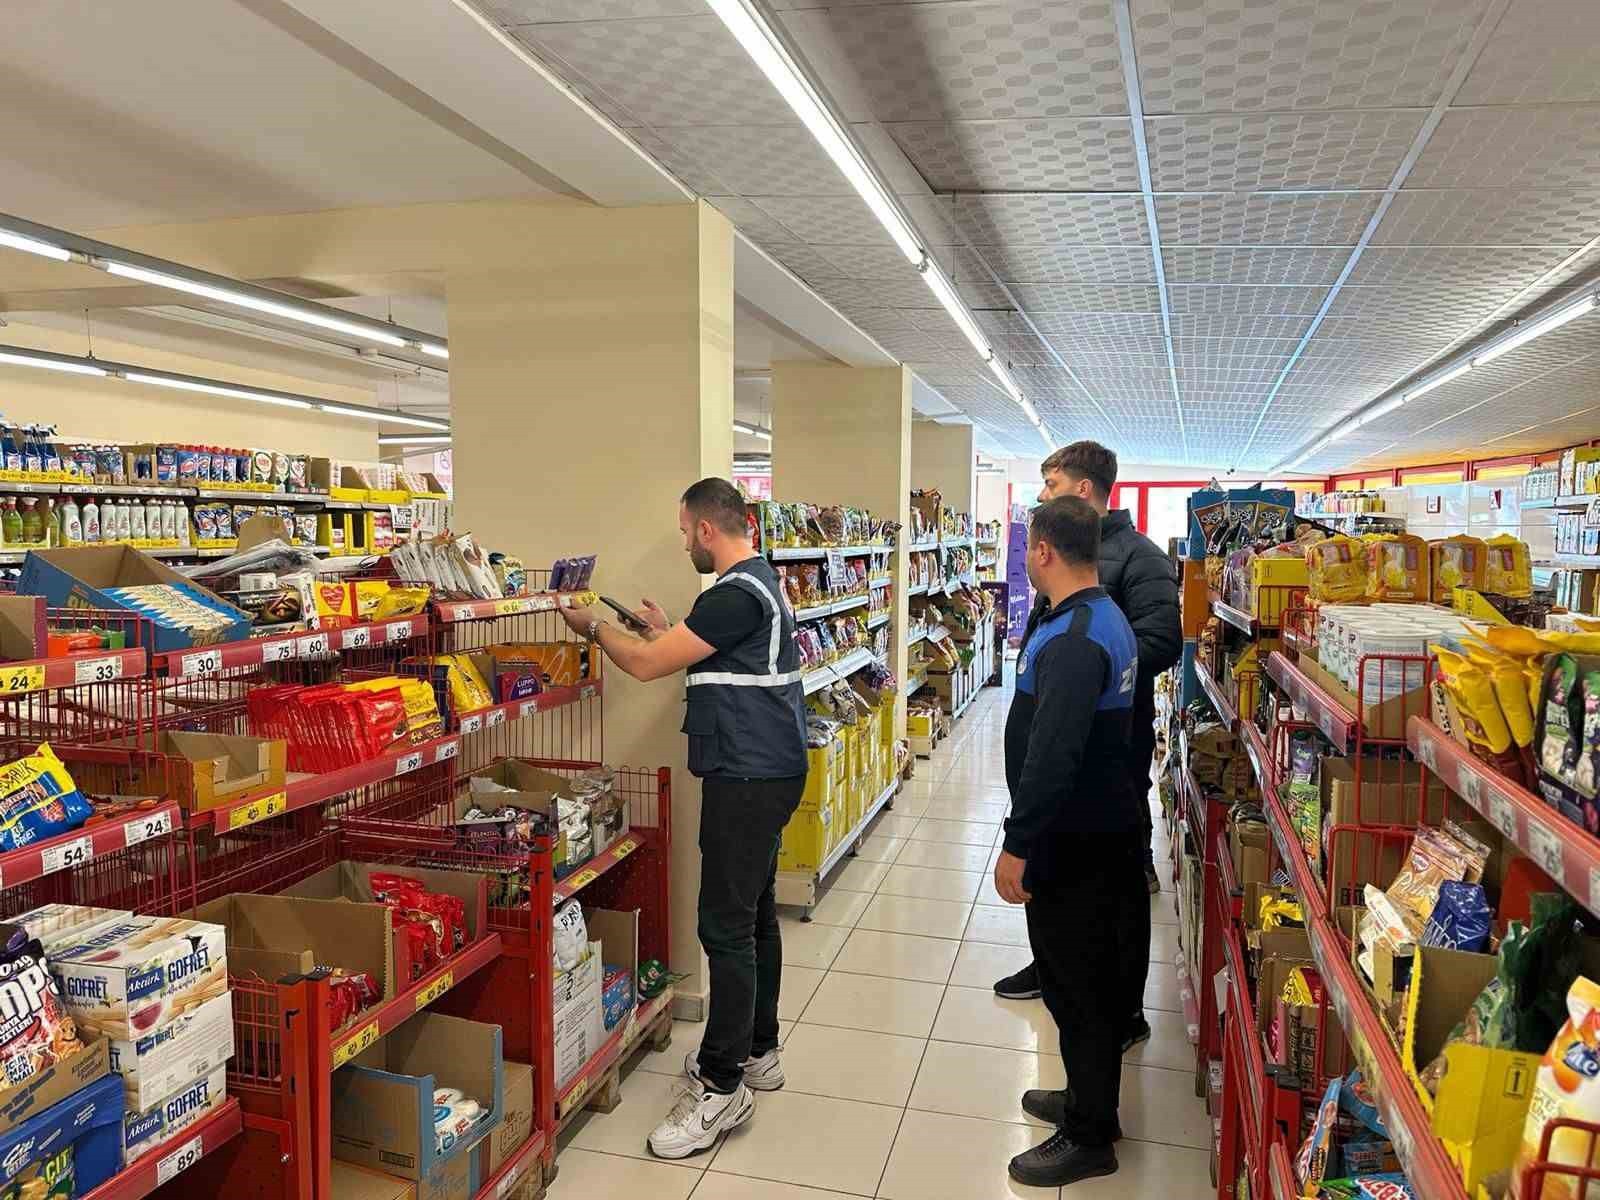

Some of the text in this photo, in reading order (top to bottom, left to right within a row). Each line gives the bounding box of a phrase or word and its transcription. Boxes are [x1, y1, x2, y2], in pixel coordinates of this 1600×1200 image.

[353, 633, 365, 645] 69
[396, 627, 408, 638] 50
[278, 646, 290, 658] 75
[309, 639, 322, 652] 60
[96, 665, 114, 681] 33
[198, 657, 215, 673] 30
[10, 676, 29, 691] 24
[145, 820, 164, 838] 24
[63, 846, 84, 866] 54
[168, 949, 209, 983] GOFRET
[67, 976, 108, 999] GOFRET
[167, 1081, 209, 1123] GOFRET
[176, 1150, 195, 1172] 89
